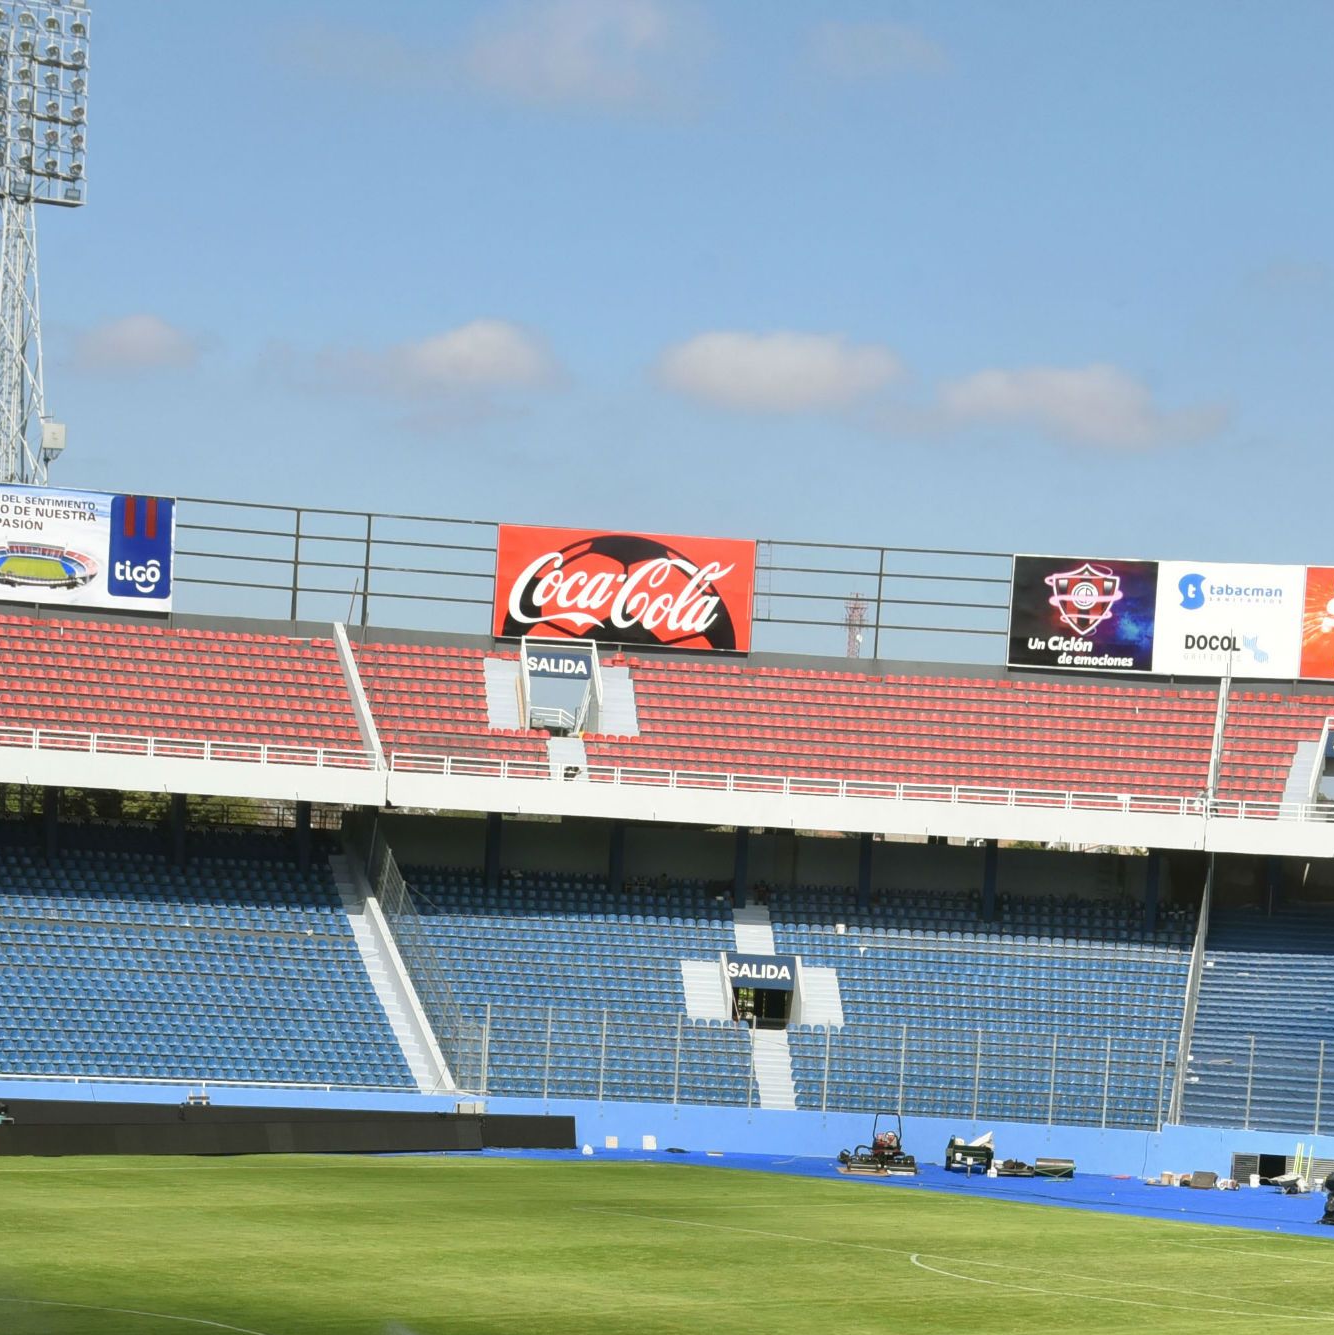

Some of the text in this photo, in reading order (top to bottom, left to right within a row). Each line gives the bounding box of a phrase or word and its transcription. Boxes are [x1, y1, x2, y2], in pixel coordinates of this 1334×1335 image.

[1, 494, 21, 504] DEL
[13, 506, 32, 517] DE
[35, 507, 97, 522] NUESTRA
[508, 551, 736, 634] Coca-Cola
[1210, 584, 1283, 597] tabacman
[1027, 635, 1093, 652] Un Ciclón
[1185, 634, 1241, 652] DOCOL
[527, 656, 588, 675] SALIDA
[1057, 651, 1134, 667] de emociones
[727, 962, 791, 980] SALIDA
